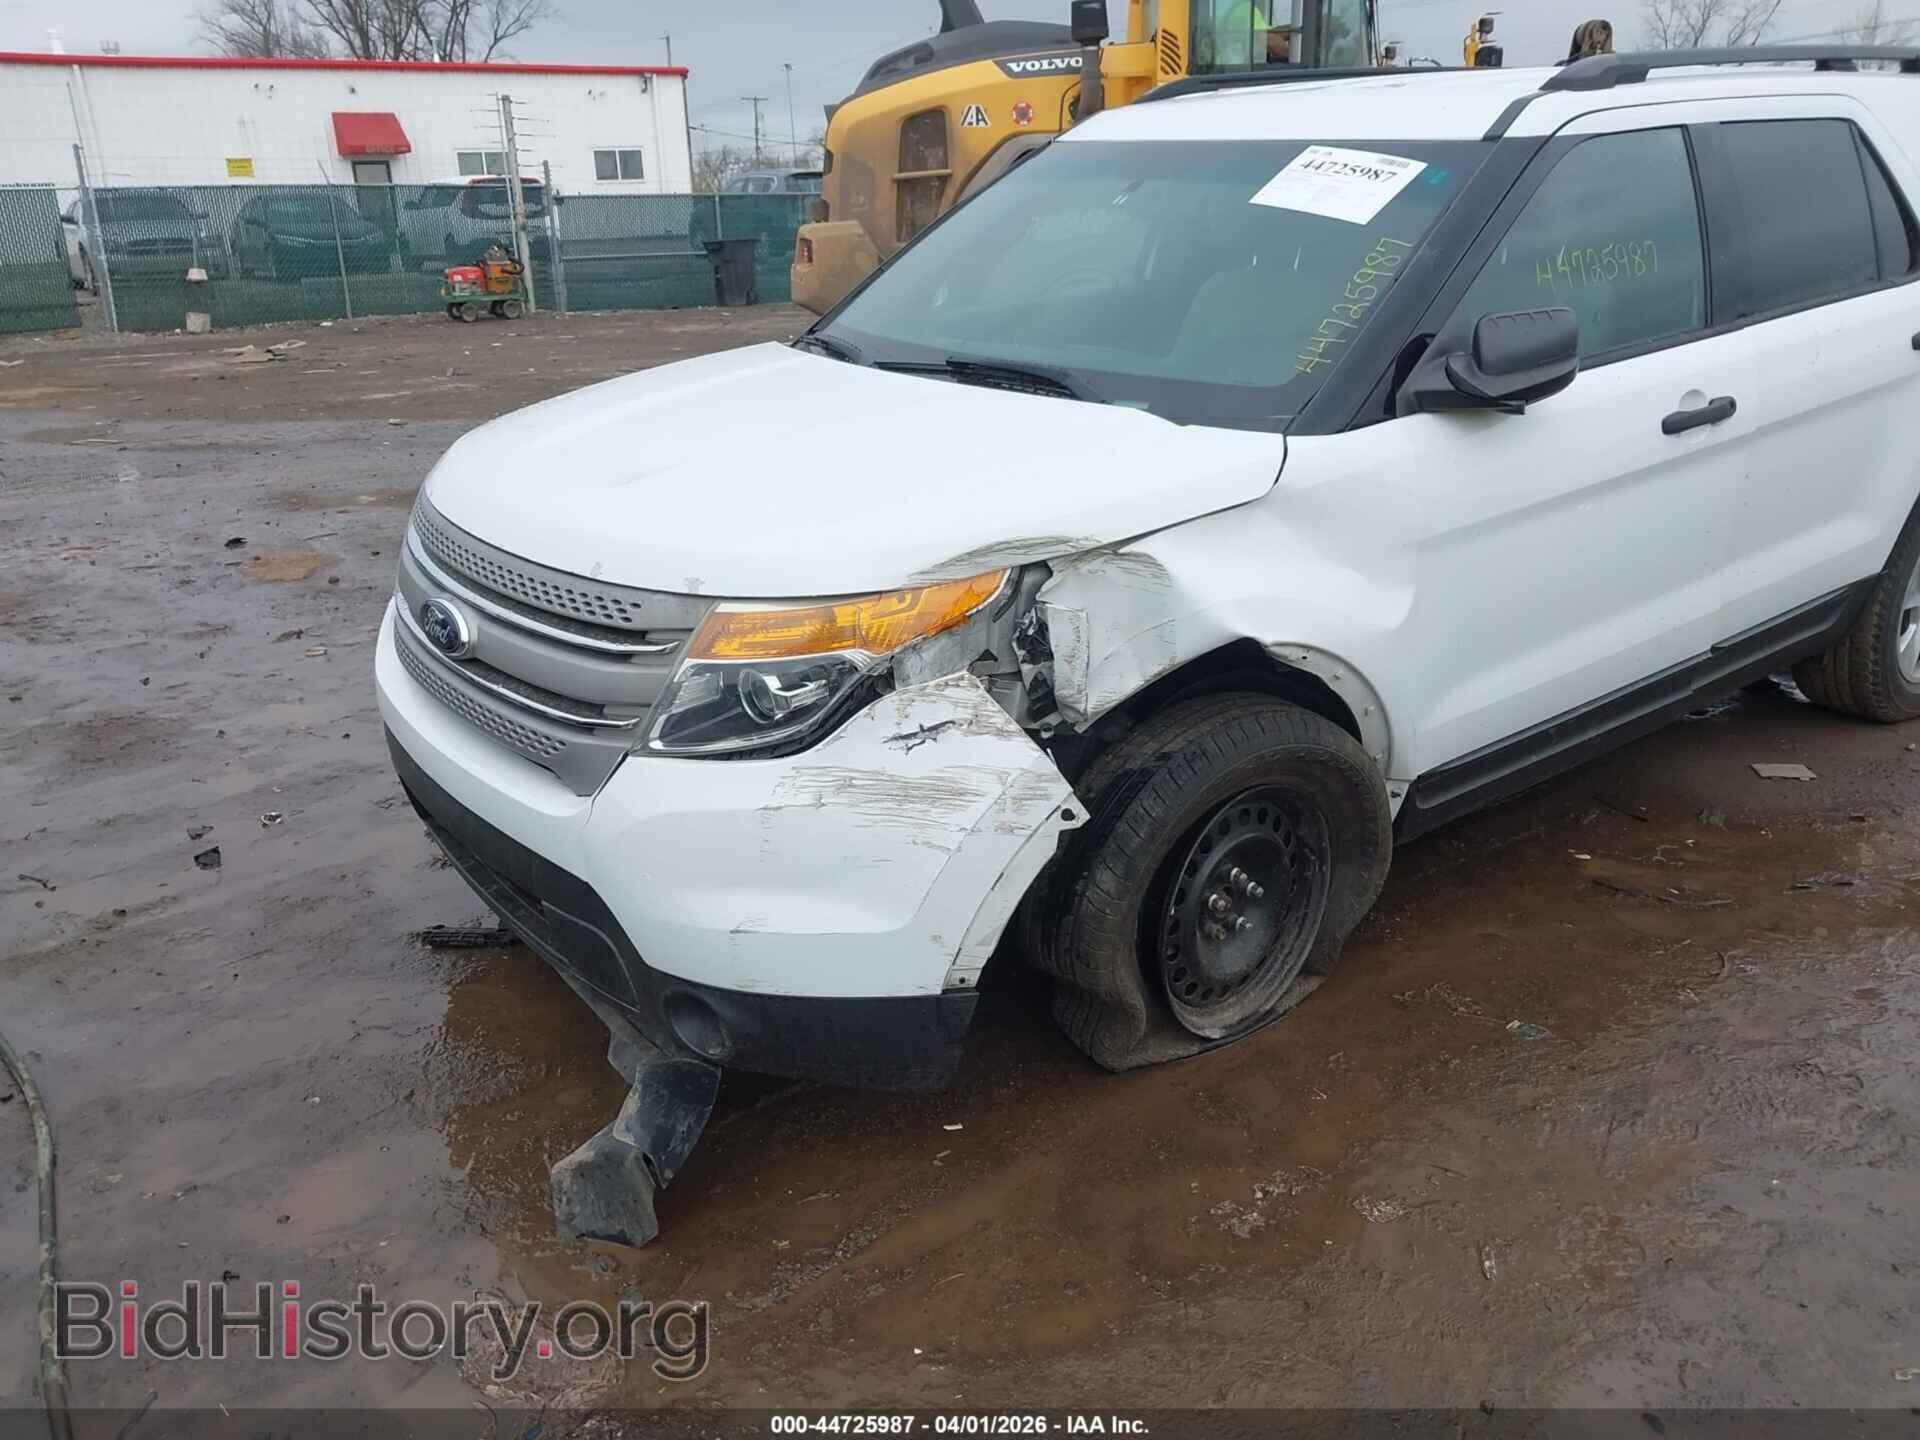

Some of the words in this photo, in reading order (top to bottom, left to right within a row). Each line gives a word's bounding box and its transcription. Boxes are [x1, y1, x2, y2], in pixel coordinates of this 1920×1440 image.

[1007, 57, 1082, 72] VOLVO
[1301, 159, 1398, 183] 44725987
[1536, 240, 1658, 290] 44725987
[1295, 237, 1414, 374] 44725987
[424, 606, 450, 644] Ford
